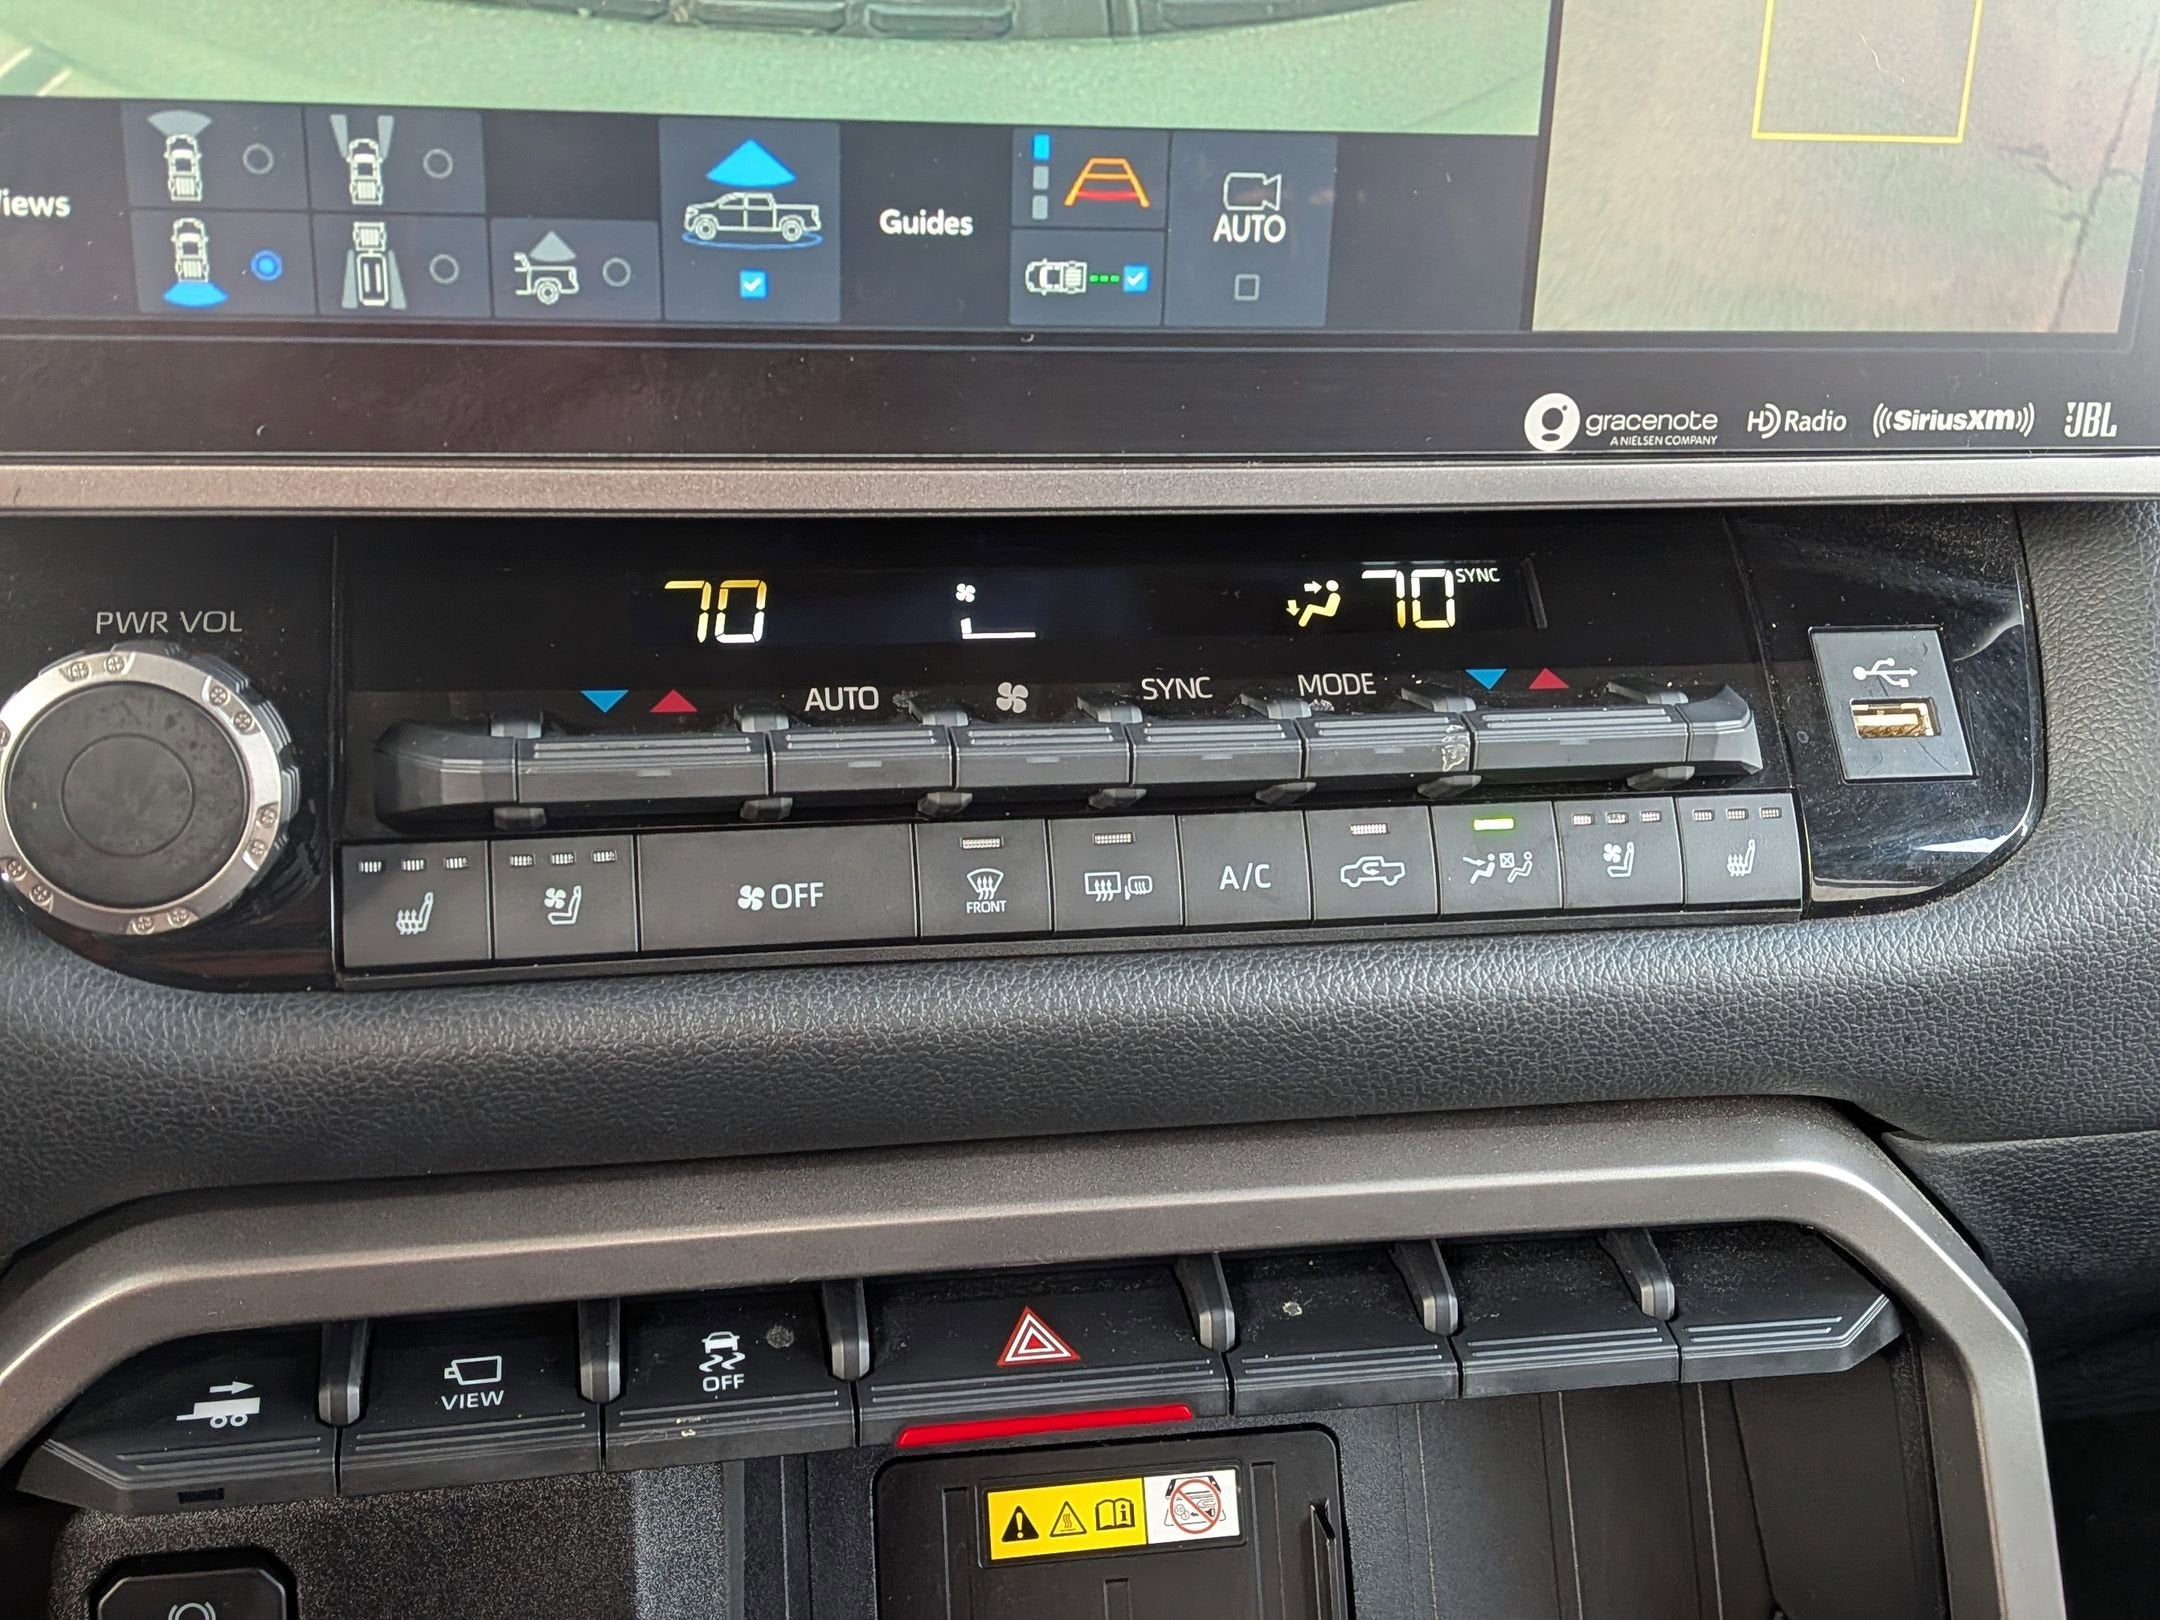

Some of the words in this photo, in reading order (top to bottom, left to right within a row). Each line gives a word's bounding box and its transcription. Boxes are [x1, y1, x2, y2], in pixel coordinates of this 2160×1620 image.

[0, 188, 71, 218] iews
[878, 207, 975, 237] Guides
[1212, 213, 1287, 244] AUTO
[1585, 410, 1719, 437] gracenote
[1784, 408, 1848, 433] Radio
[2063, 401, 2118, 438] JBL
[1609, 436, 1619, 447] A
[1620, 435, 1664, 447] NIELSEN
[1666, 434, 1719, 447] COMPANY
[1455, 567, 1501, 583] SYNC
[664, 579, 768, 645] 70
[1361, 568, 1456, 629] 70
[96, 610, 169, 634] PWR
[179, 610, 243, 633] VOL
[1141, 676, 1214, 700] SYNC
[1298, 672, 1377, 697] MODE
[804, 686, 880, 713] AUTO
[1219, 862, 1272, 891] A/C
[770, 881, 825, 909] OFF
[966, 899, 1008, 914] FRONT
[702, 1373, 746, 1393] OFF
[441, 1389, 505, 1411] VIEW
